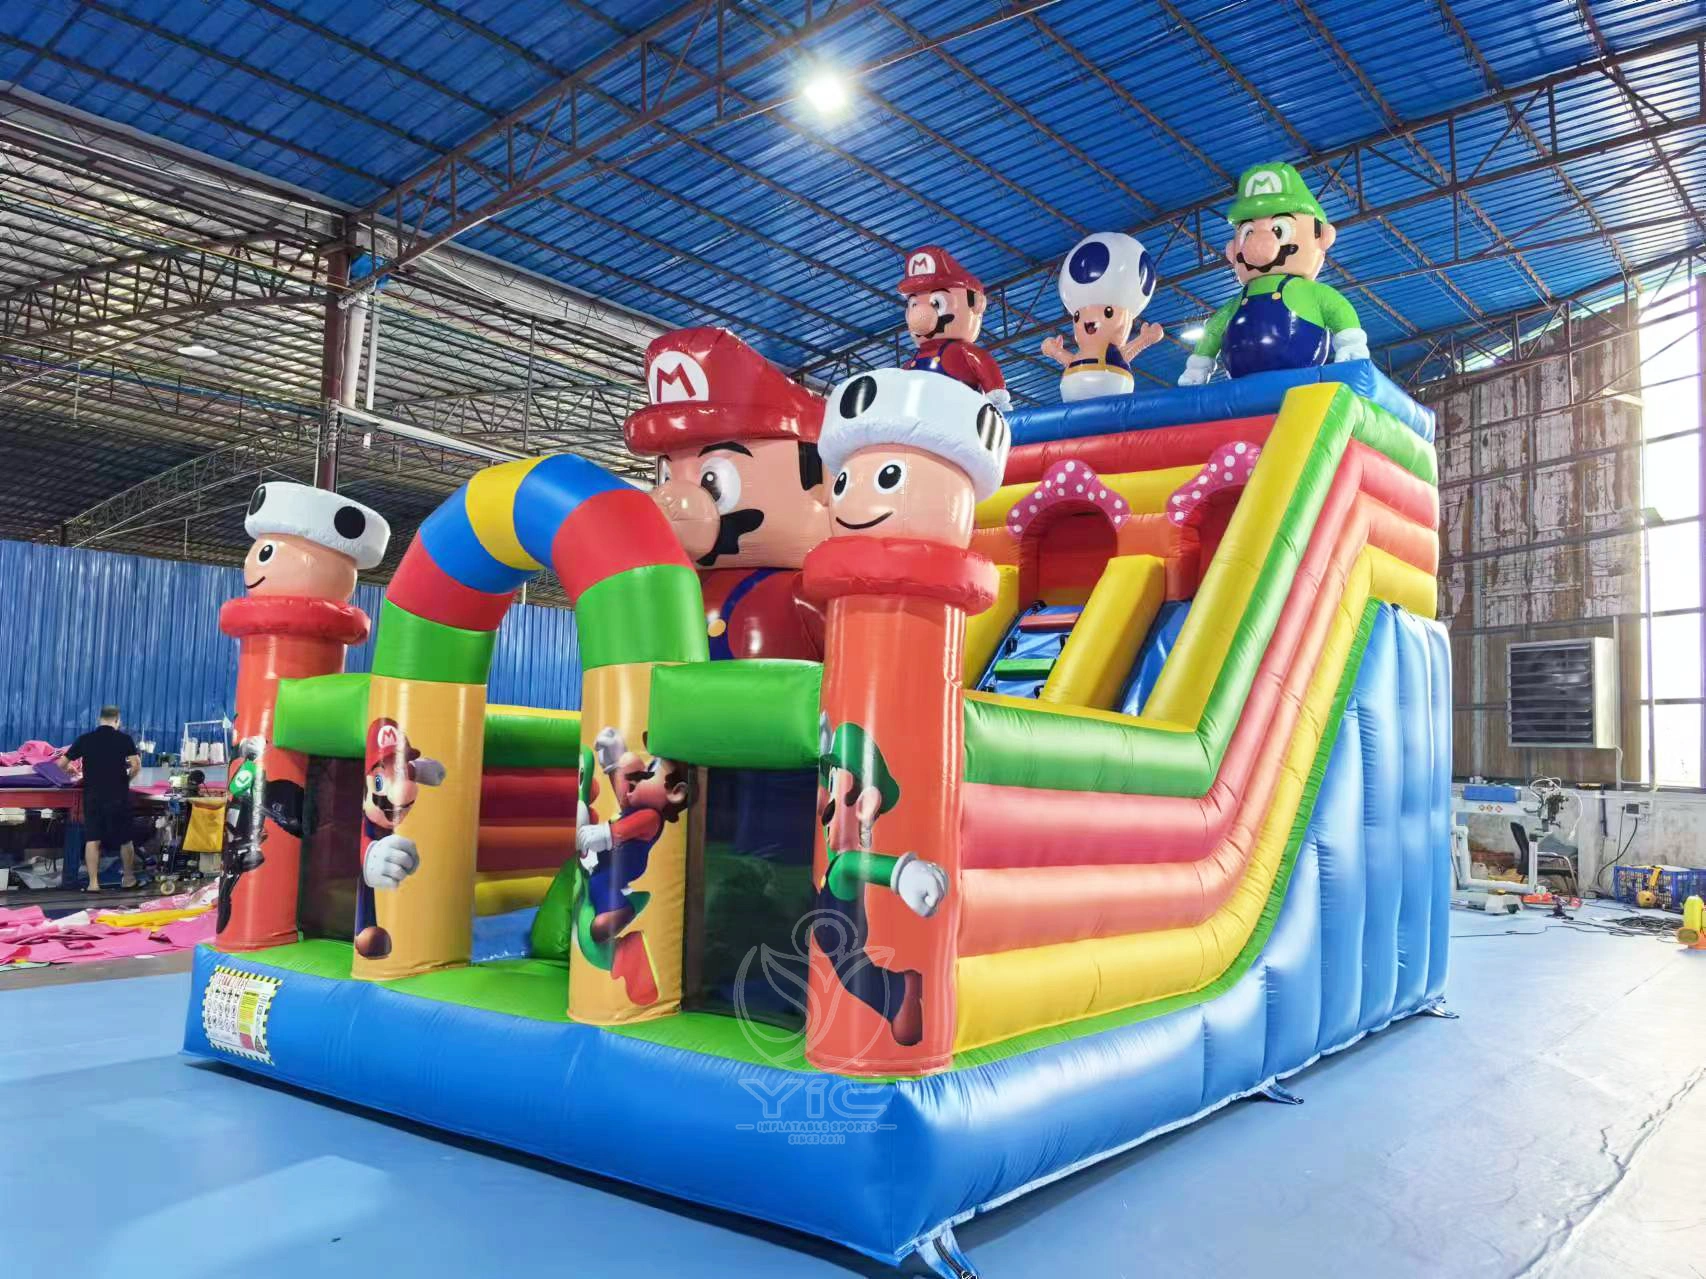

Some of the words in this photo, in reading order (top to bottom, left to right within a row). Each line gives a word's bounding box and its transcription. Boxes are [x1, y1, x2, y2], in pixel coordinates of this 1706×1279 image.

[1250, 176, 1275, 196] M
[911, 257, 928, 274] M
[656, 362, 697, 403] M
[381, 728, 397, 745] M
